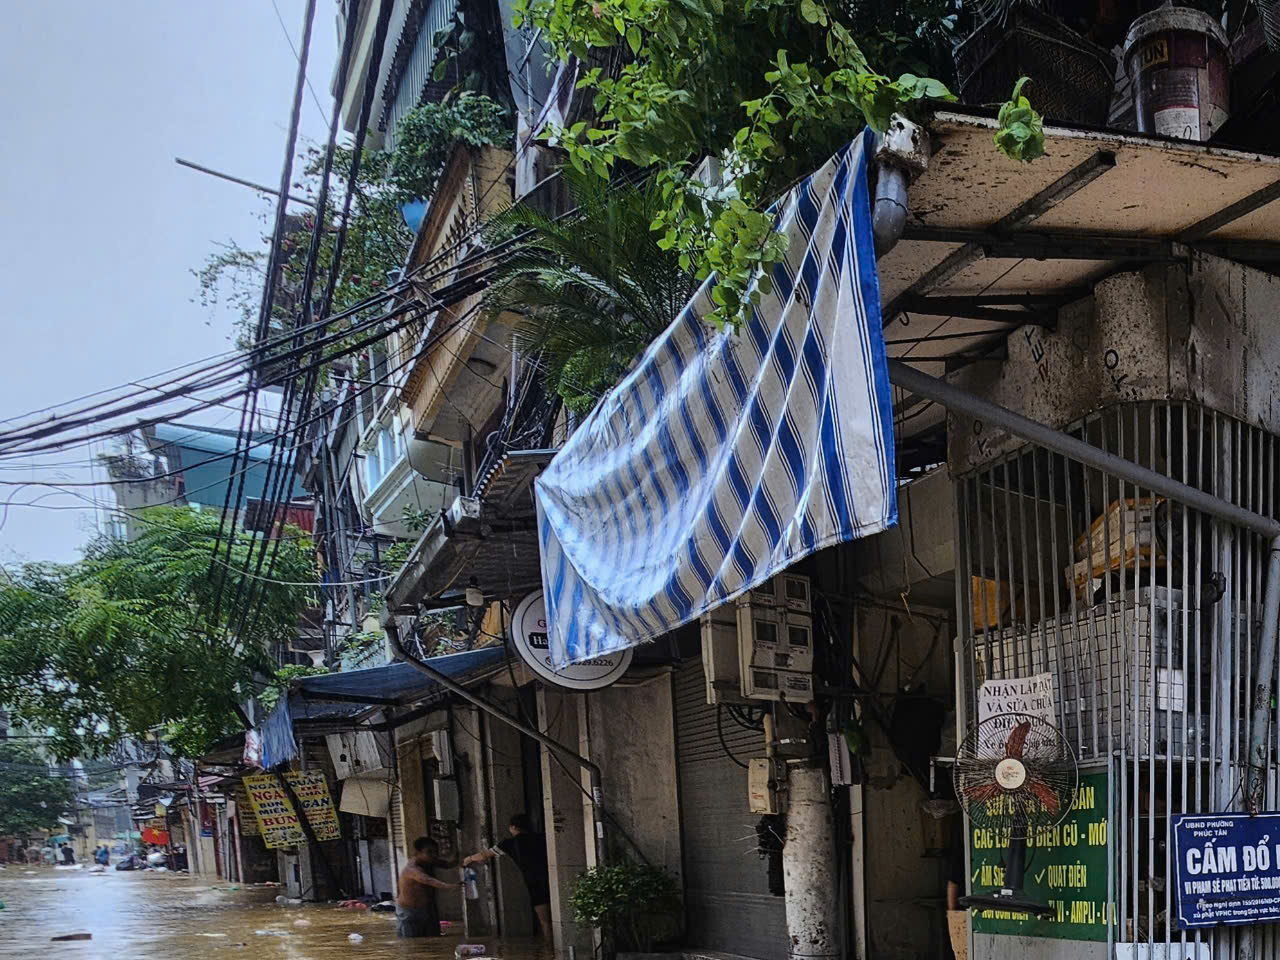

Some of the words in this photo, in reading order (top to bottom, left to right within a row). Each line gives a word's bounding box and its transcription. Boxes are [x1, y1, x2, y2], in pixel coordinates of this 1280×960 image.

[984, 684, 1018, 699] NHẬN
[987, 698, 1003, 713] VÀ
[1006, 698, 1028, 712] SỬA
[252, 790, 287, 802] NGA
[302, 797, 330, 809] GAN
[1185, 821, 1205, 829] UBND
[1206, 820, 1234, 828] PHƯỜNG
[974, 824, 993, 849] CÁC
[1063, 819, 1078, 847] CŨ
[1088, 817, 1110, 846] MỚ
[1193, 829, 1213, 837] PHÚC
[1214, 828, 1228, 836] TÂN
[1186, 838, 1238, 875] CẤM
[1242, 834, 1270, 872] ĐỔ
[1048, 865, 1068, 892] QUẠT
[1068, 859, 1087, 892] ĐIỆN
[1192, 880, 1211, 897] PHẠM
[1071, 901, 1095, 924] AMPLI
[1102, 901, 1118, 926] LA
[1215, 909, 1232, 917] VPHC
